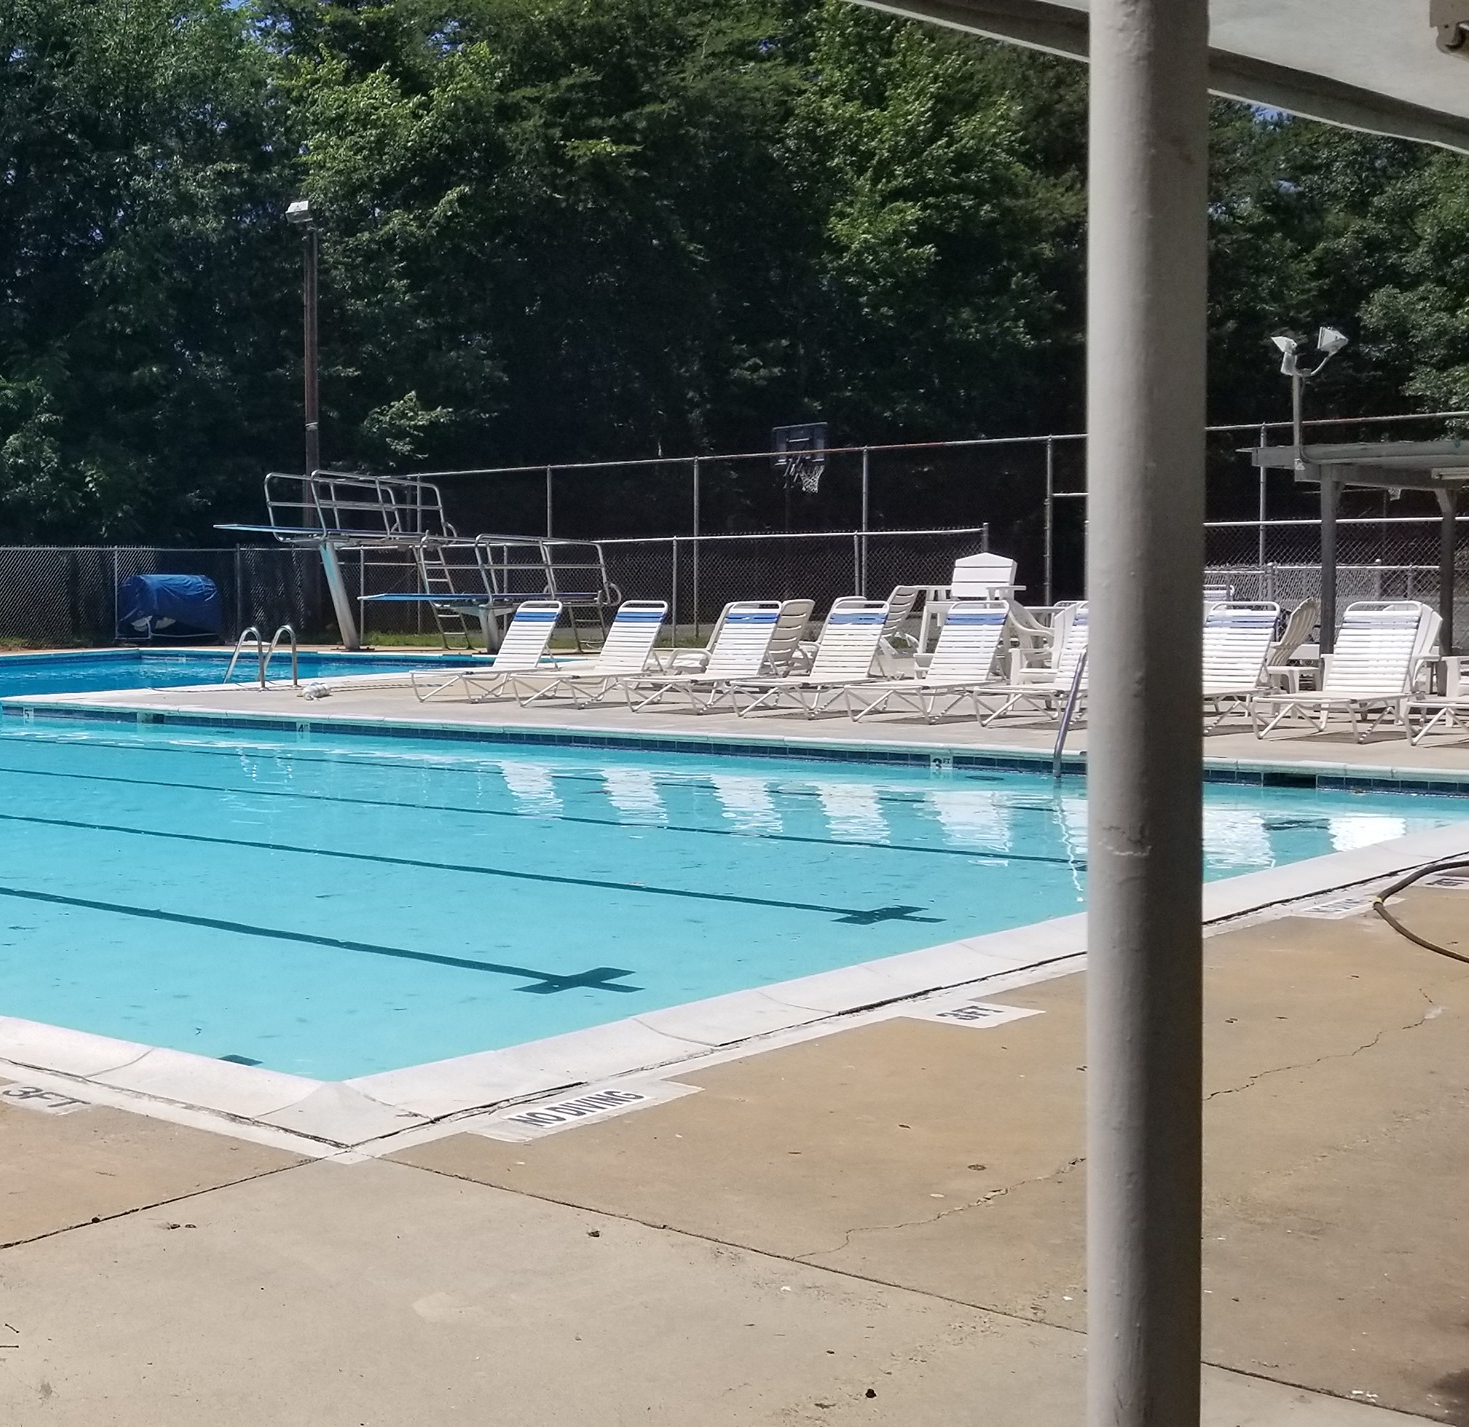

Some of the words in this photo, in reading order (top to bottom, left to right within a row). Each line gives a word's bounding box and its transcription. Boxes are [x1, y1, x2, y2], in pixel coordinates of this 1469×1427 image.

[936, 1005, 1004, 1021] 3FT
[2, 1086, 91, 1108] 3FT
[508, 1111, 566, 1127] NO
[546, 1090, 645, 1117] DIVING
